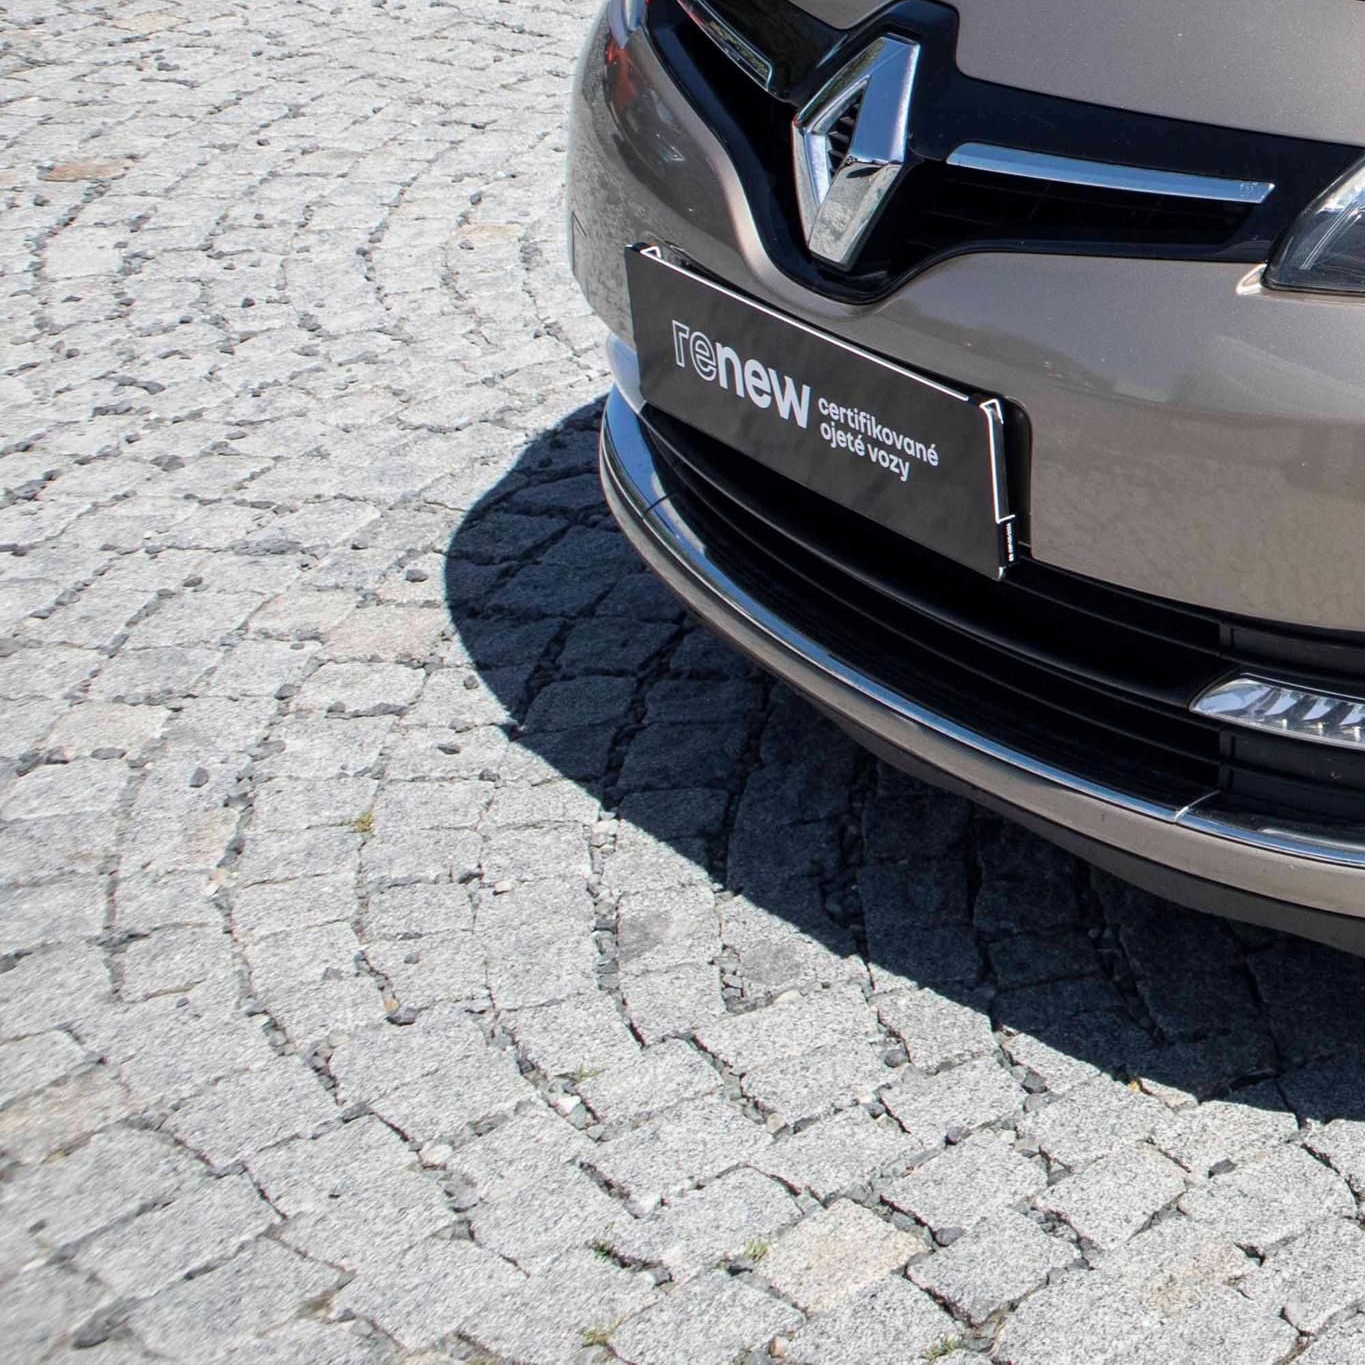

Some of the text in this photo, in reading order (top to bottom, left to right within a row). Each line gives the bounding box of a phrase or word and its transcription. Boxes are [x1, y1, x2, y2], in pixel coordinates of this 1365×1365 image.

[672, 319, 811, 429] renew
[817, 397, 940, 467] certifikované
[820, 422, 911, 482] ojeté vozy
